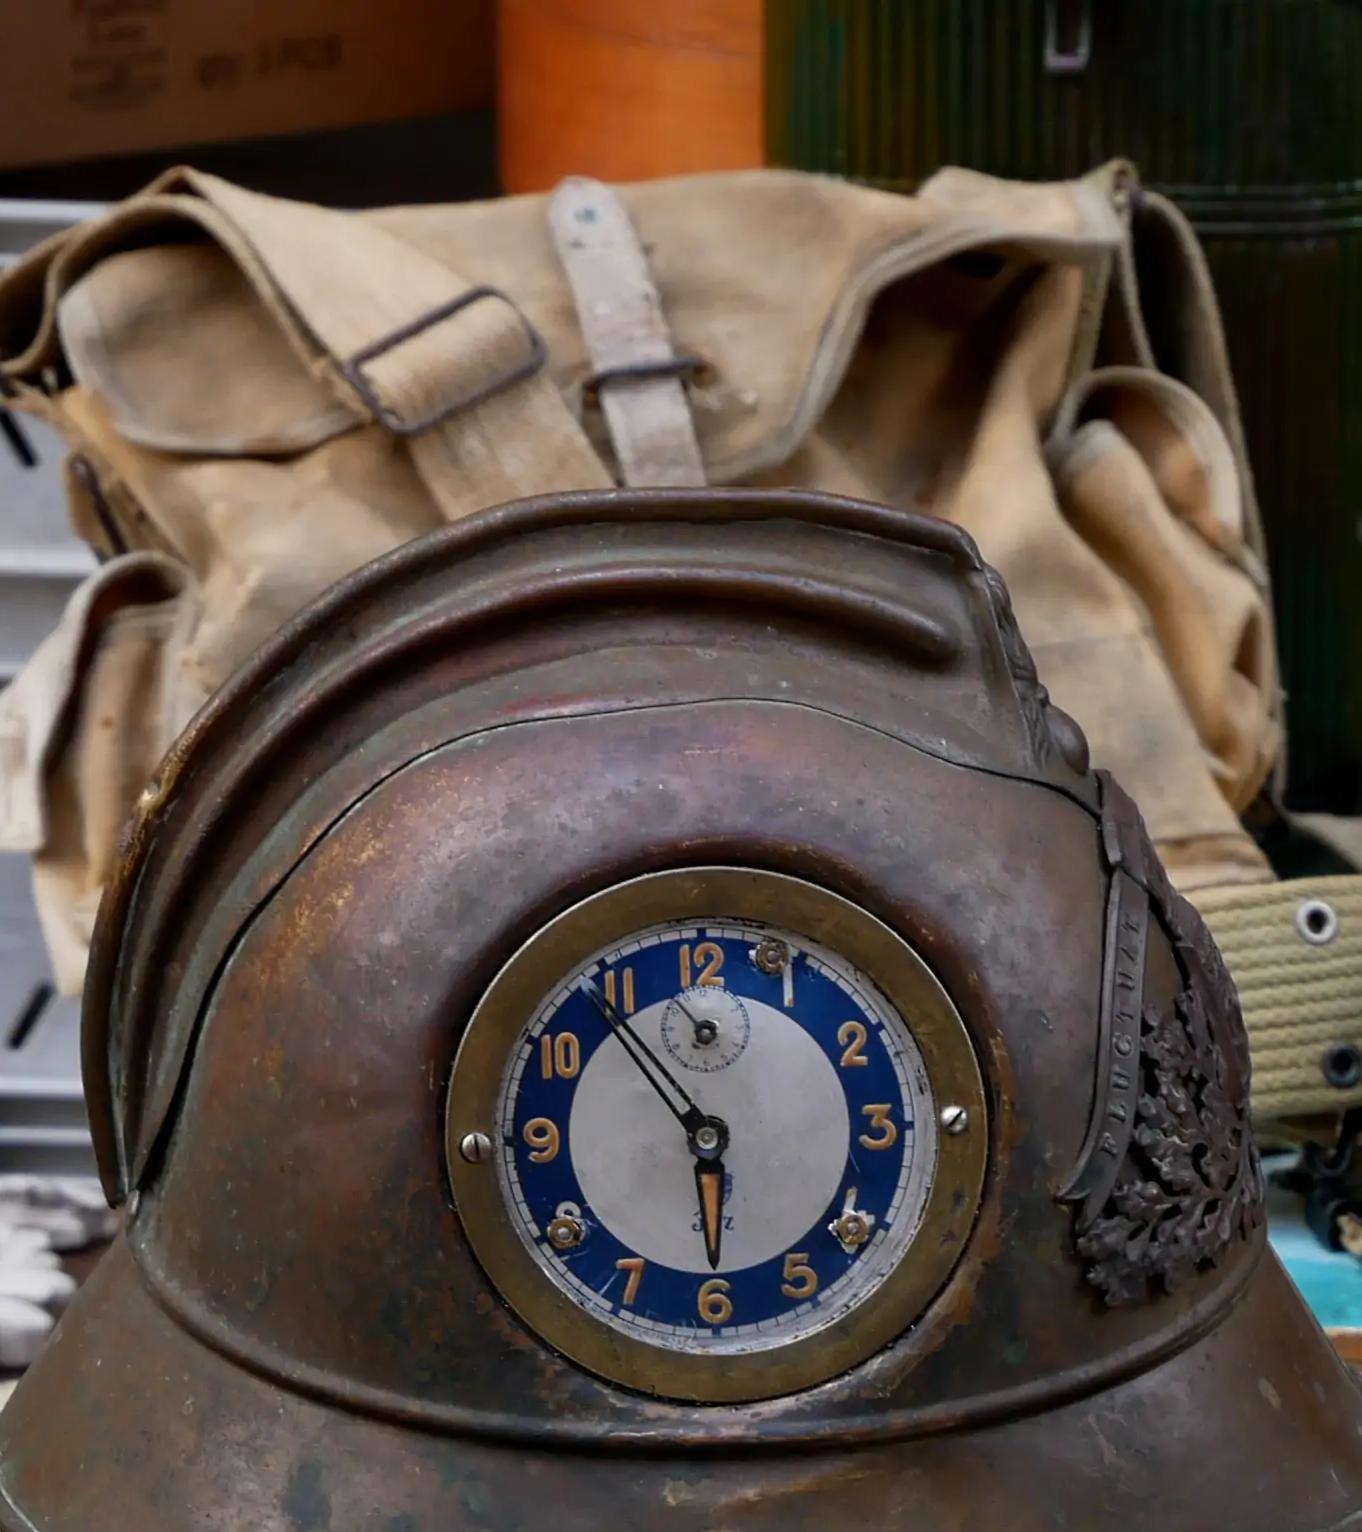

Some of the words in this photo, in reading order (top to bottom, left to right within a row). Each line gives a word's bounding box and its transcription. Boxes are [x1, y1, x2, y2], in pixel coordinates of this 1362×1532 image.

[679, 941, 725, 989] 12
[604, 966, 635, 1014] 11
[541, 1031, 581, 1080] 10
[837, 1020, 868, 1067] 2
[522, 1117, 560, 1163] 9
[858, 1103, 897, 1151] 3
[615, 1257, 645, 1305] 7
[780, 1252, 818, 1299] 5
[698, 1278, 733, 1324] 6
